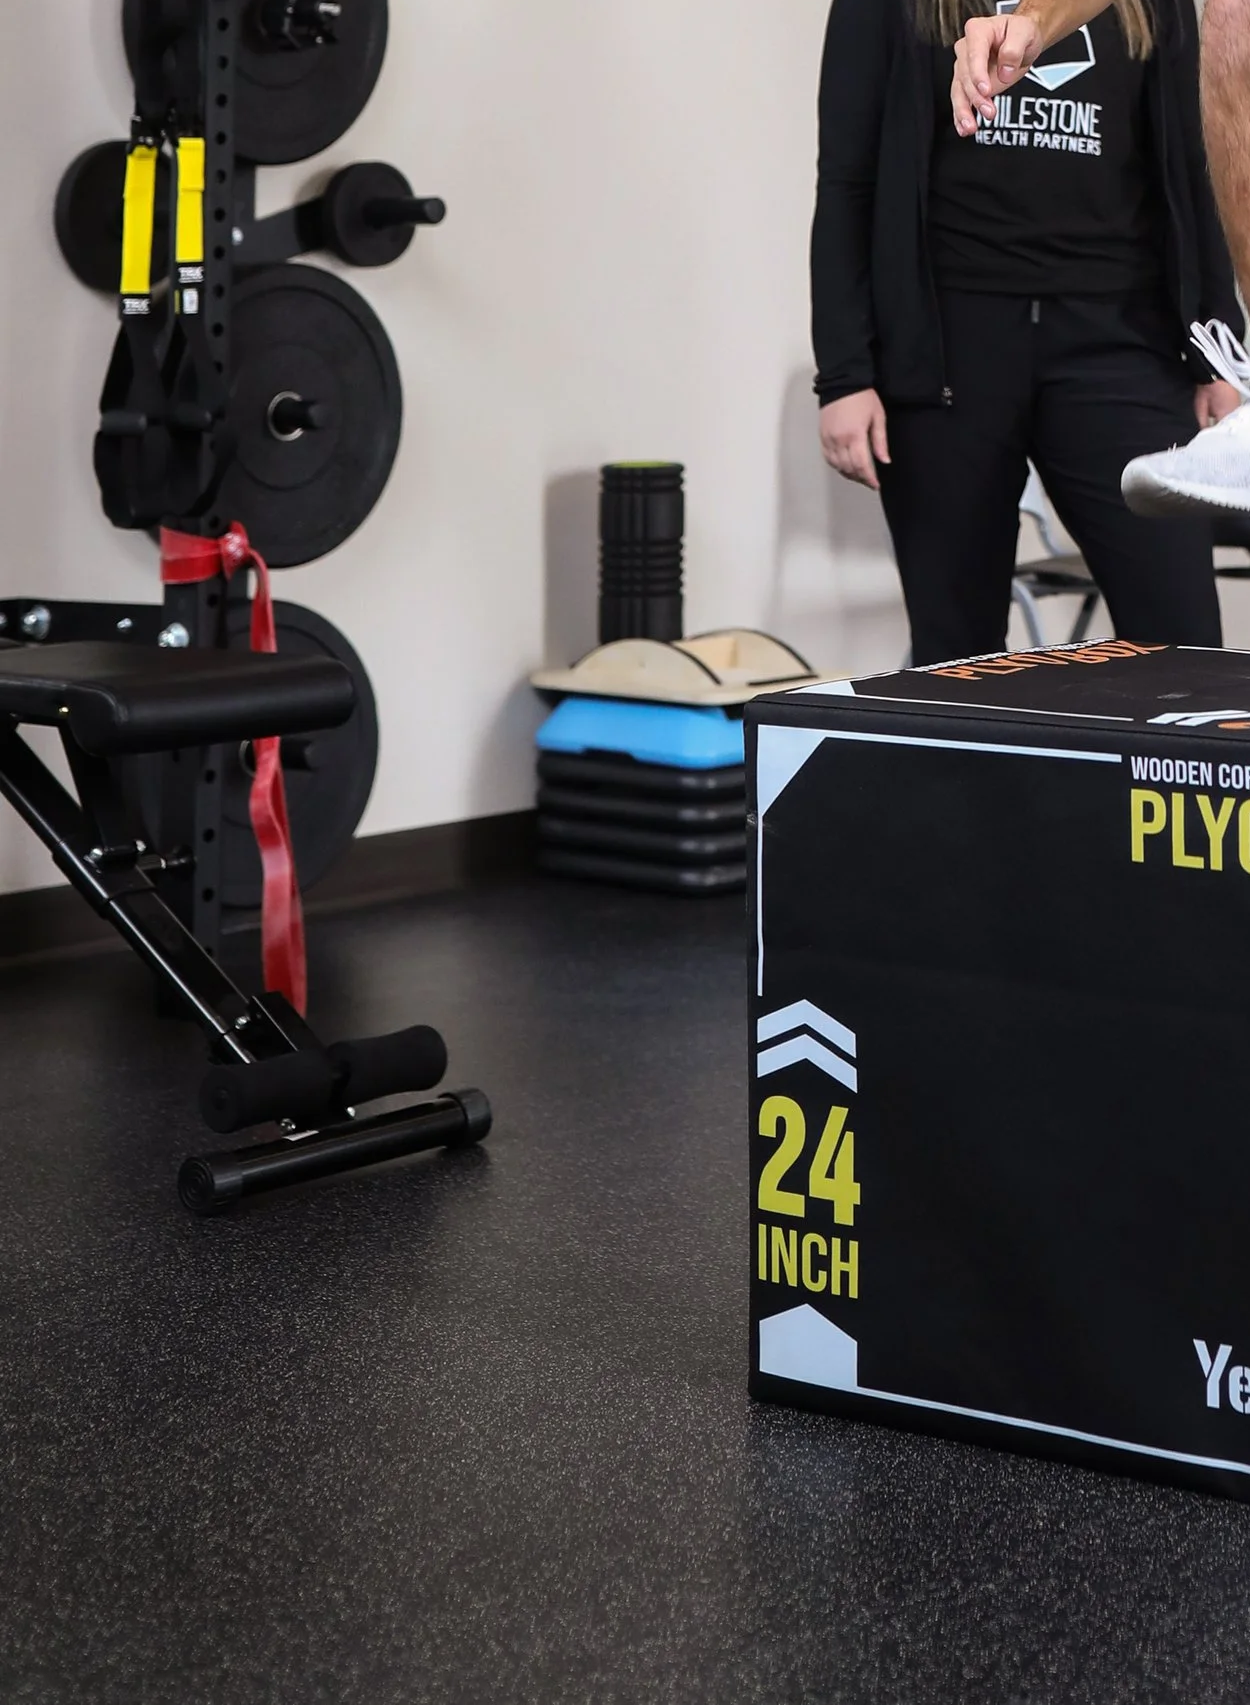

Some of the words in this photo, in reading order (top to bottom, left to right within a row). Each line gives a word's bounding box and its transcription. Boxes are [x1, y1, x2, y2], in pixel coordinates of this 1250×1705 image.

[975, 129, 1028, 147] HEALTH
[1033, 134, 1102, 156] PARTNERS
[1130, 755, 1213, 787] WOODEN
[758, 1095, 861, 1227] 24
[758, 1222, 859, 1299] INCH
